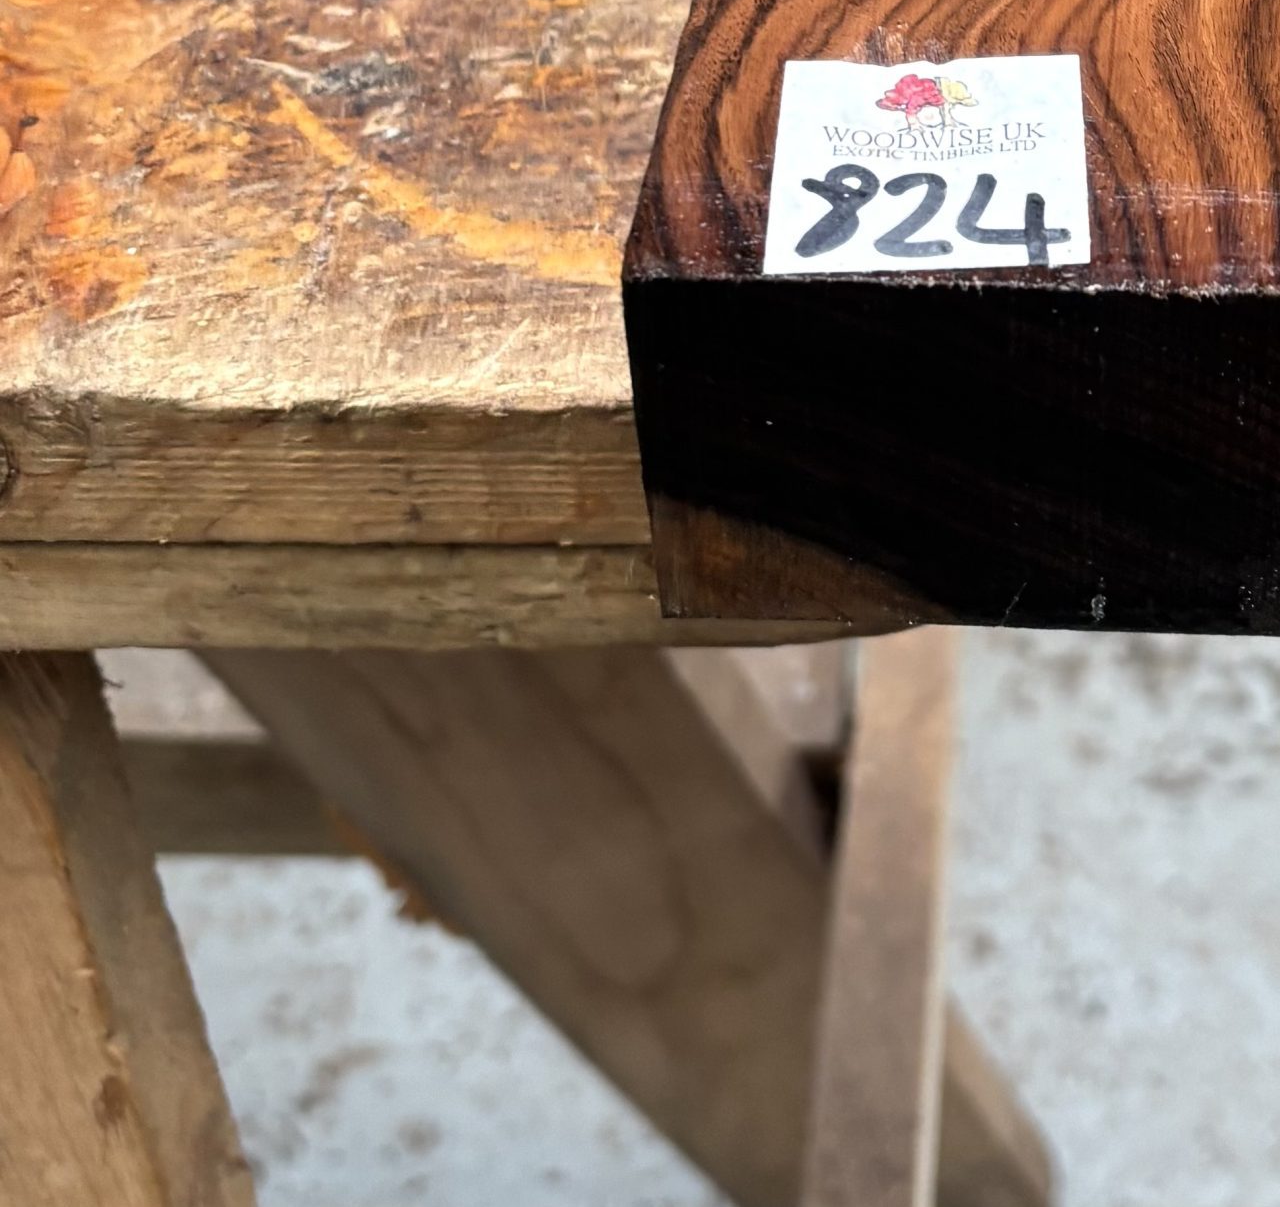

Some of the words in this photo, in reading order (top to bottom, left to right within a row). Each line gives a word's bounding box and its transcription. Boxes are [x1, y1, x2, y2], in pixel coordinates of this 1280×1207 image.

[823, 125, 993, 149] WOODWISE
[1002, 122, 1047, 141] UK
[832, 144, 904, 160] EXOTIC
[910, 144, 993, 161] TIMBERS
[999, 139, 1037, 152] LTD
[795, 163, 1072, 267] 824
